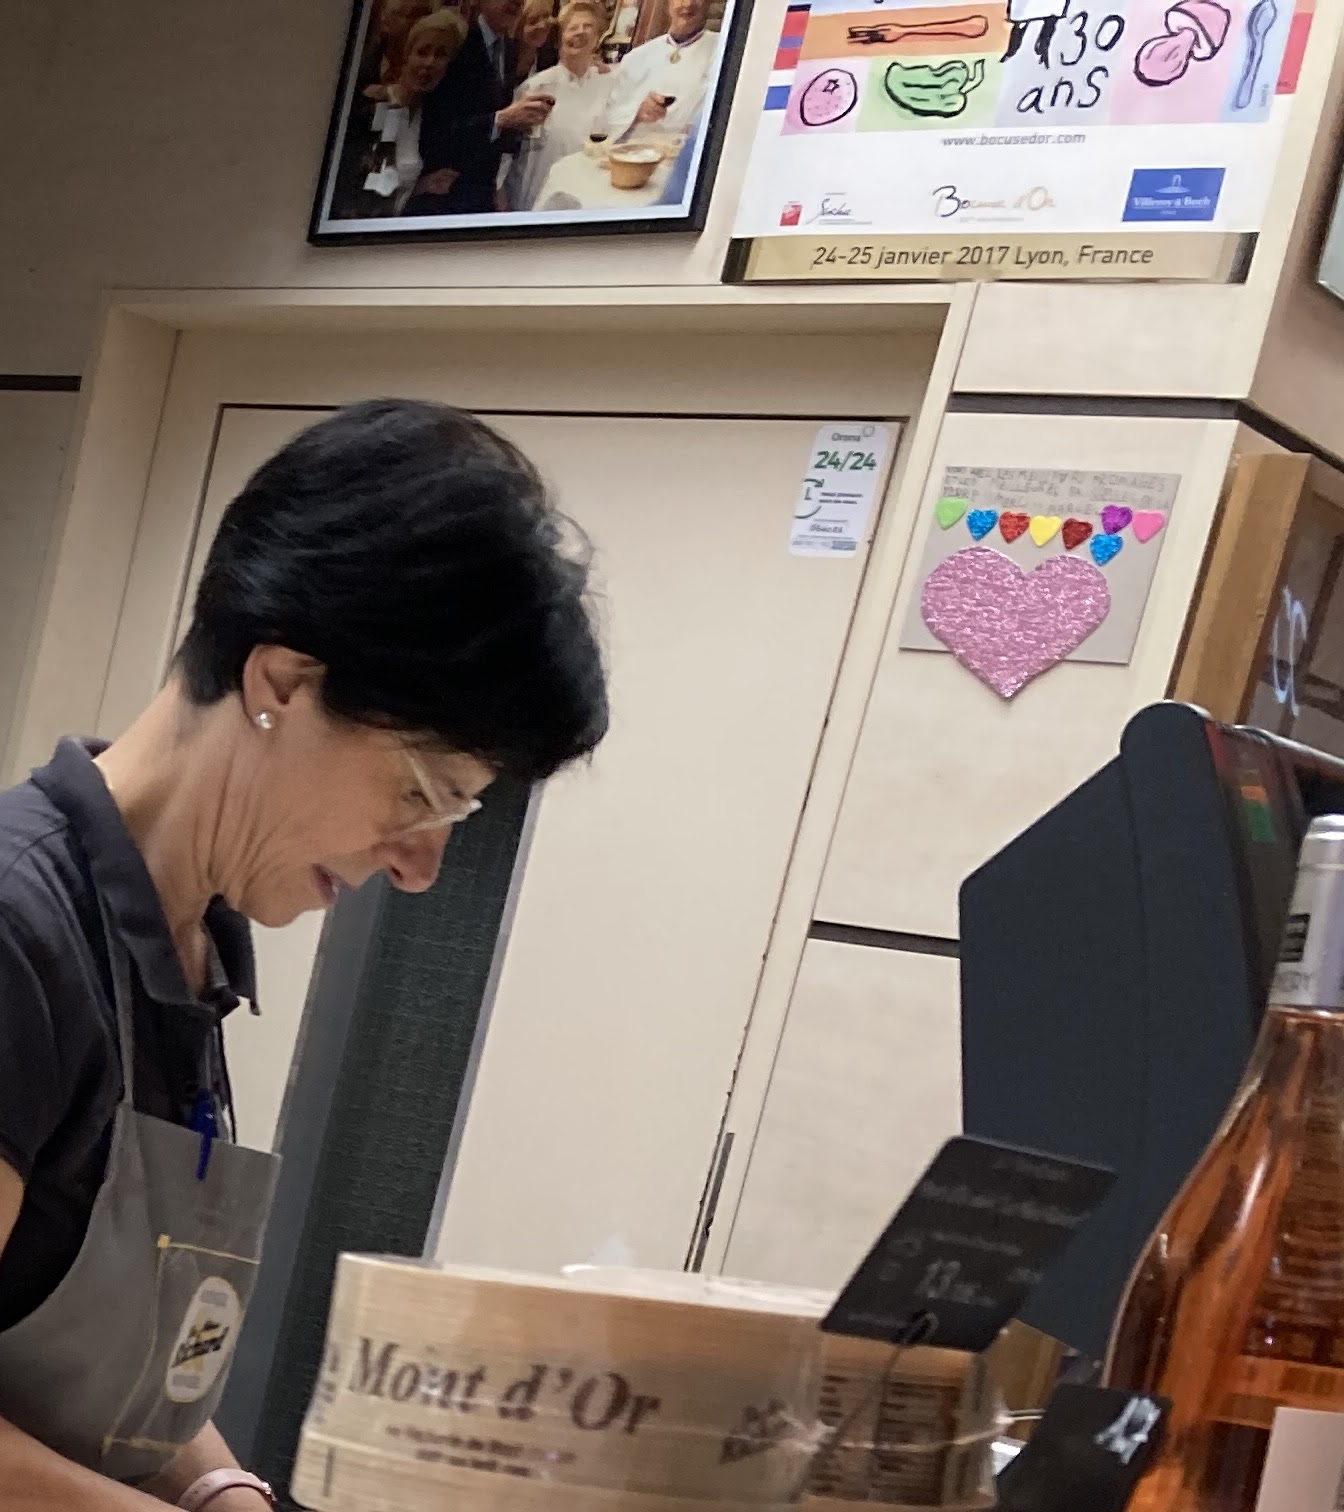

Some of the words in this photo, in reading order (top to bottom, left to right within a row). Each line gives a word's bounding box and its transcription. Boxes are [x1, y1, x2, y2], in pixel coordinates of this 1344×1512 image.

[1016, 65, 1110, 115] ans
[812, 246, 872, 266] 24-25
[874, 246, 949, 269] janvier
[955, 246, 1010, 265] 2017
[1013, 246, 1070, 268] Lyon,
[1077, 245, 1155, 265] France
[813, 450, 877, 472] 24/24
[346, 1336, 487, 1416] Mont
[498, 1363, 663, 1435] d'Or
